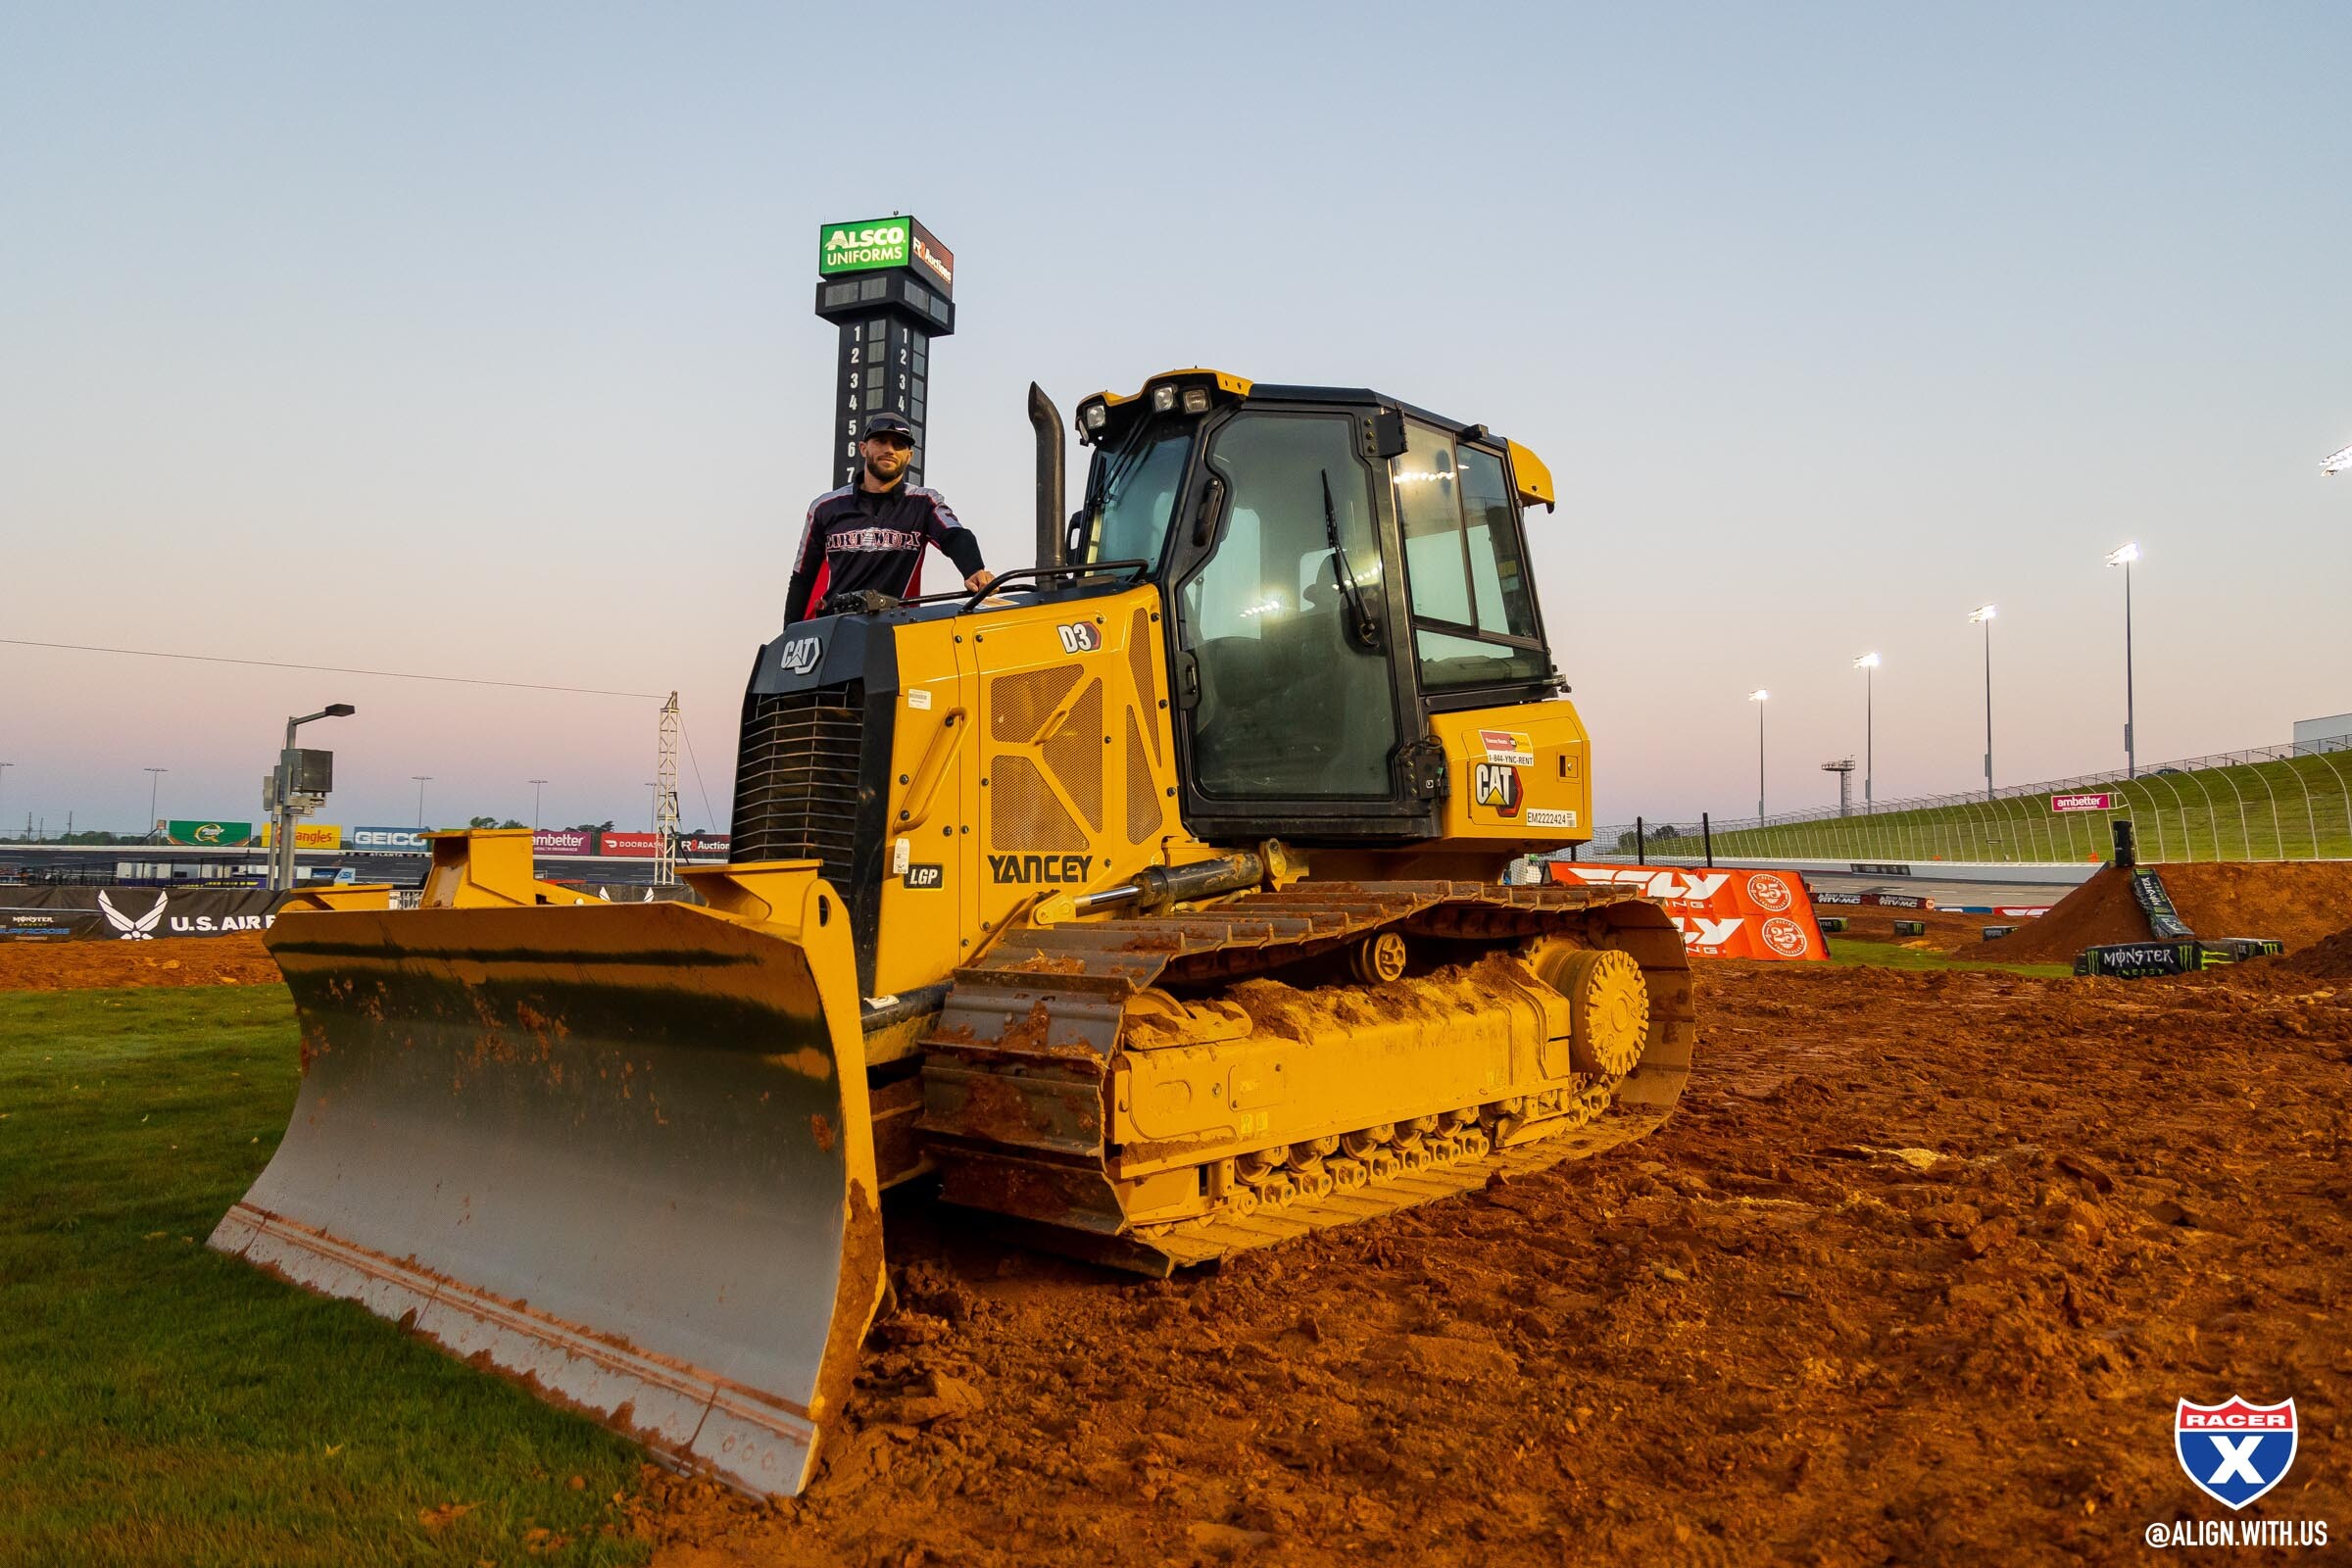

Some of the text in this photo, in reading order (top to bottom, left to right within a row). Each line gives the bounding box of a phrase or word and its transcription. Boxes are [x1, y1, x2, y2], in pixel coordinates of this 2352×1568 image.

[825, 227, 904, 251] ALSCO
[827, 247, 903, 266] UNIFORMS
[855, 325, 860, 341] 1
[903, 328, 907, 343] 1
[851, 348, 859, 364] 2
[901, 349, 906, 365] 2
[850, 373, 858, 388] 3
[900, 374, 906, 390] 3
[849, 395, 858, 410] 4
[898, 396, 905, 412] 4
[849, 419, 857, 436] 5
[848, 442, 856, 457] 6
[847, 467, 855, 483] 7
[1060, 623, 1092, 654] D3
[781, 637, 814, 668] CAT
[1489, 754, 1533, 764] 1-844-YNC-RENT
[1476, 763, 1512, 806] CAT
[2057, 796, 2102, 808] ambetter
[1527, 811, 1567, 824] EM2222424
[354, 831, 427, 847] GEICO
[909, 868, 938, 885] LGP
[988, 855, 1093, 884] YANCEY
[1755, 882, 1782, 899] 25
[171, 916, 219, 931] U.S.
[220, 915, 262, 931] AIR
[1770, 926, 1797, 944] 25
[2103, 948, 2175, 967] MONSTER
